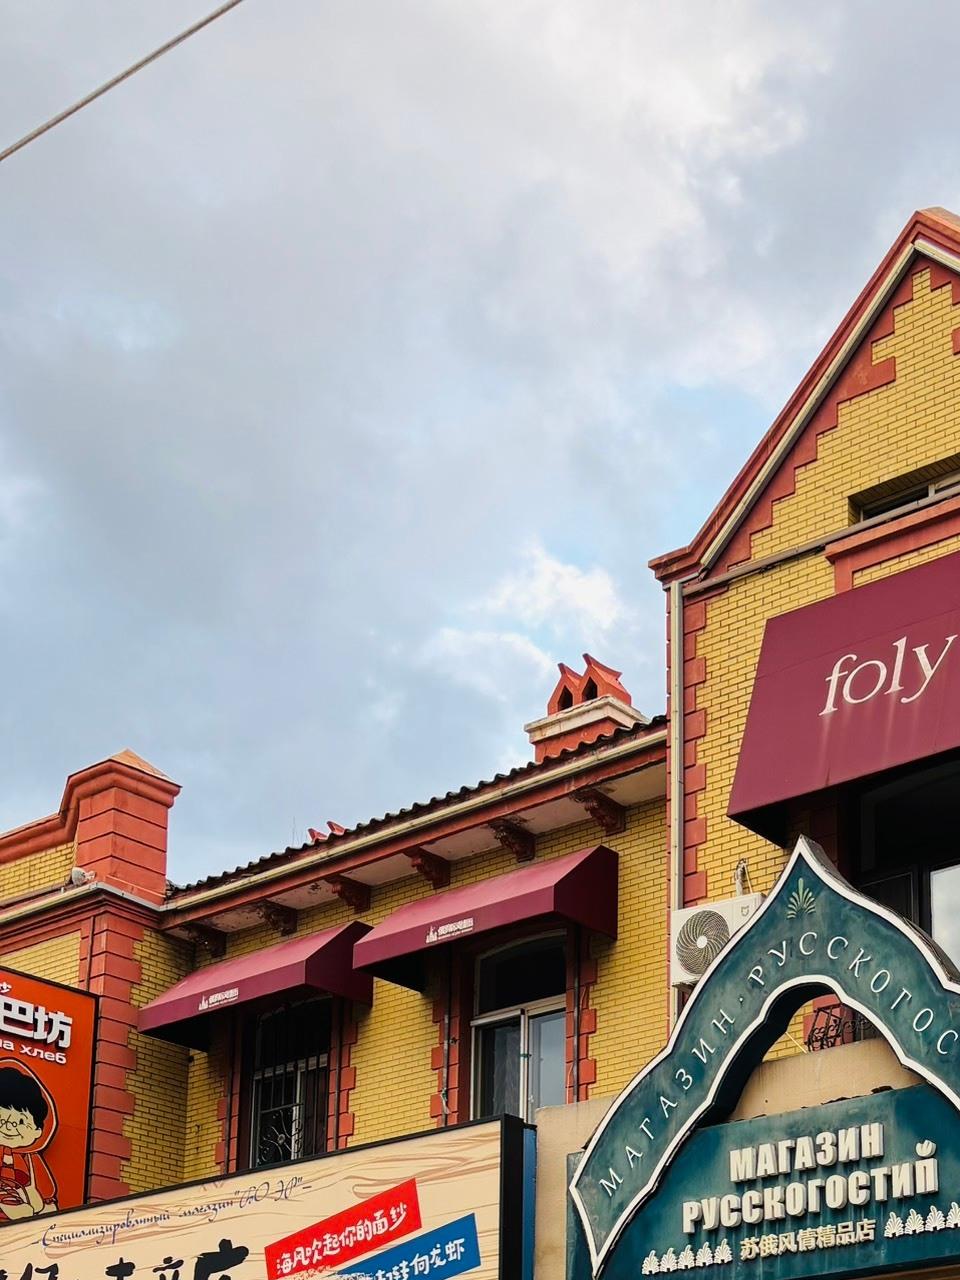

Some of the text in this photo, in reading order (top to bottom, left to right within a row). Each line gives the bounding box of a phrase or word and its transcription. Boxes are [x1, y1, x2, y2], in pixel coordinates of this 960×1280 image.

[819, 635, 957, 717] foly
[20, 1044, 67, 1065] хлеб
[598, 1007, 736, 1198] МАГАЗИН
[729, 1121, 885, 1183] МАГАЗИН
[276, 1201, 408, 1275] 海风吹起你的面纱
[740, 1217, 876, 1262] 苏俄风情精品店
